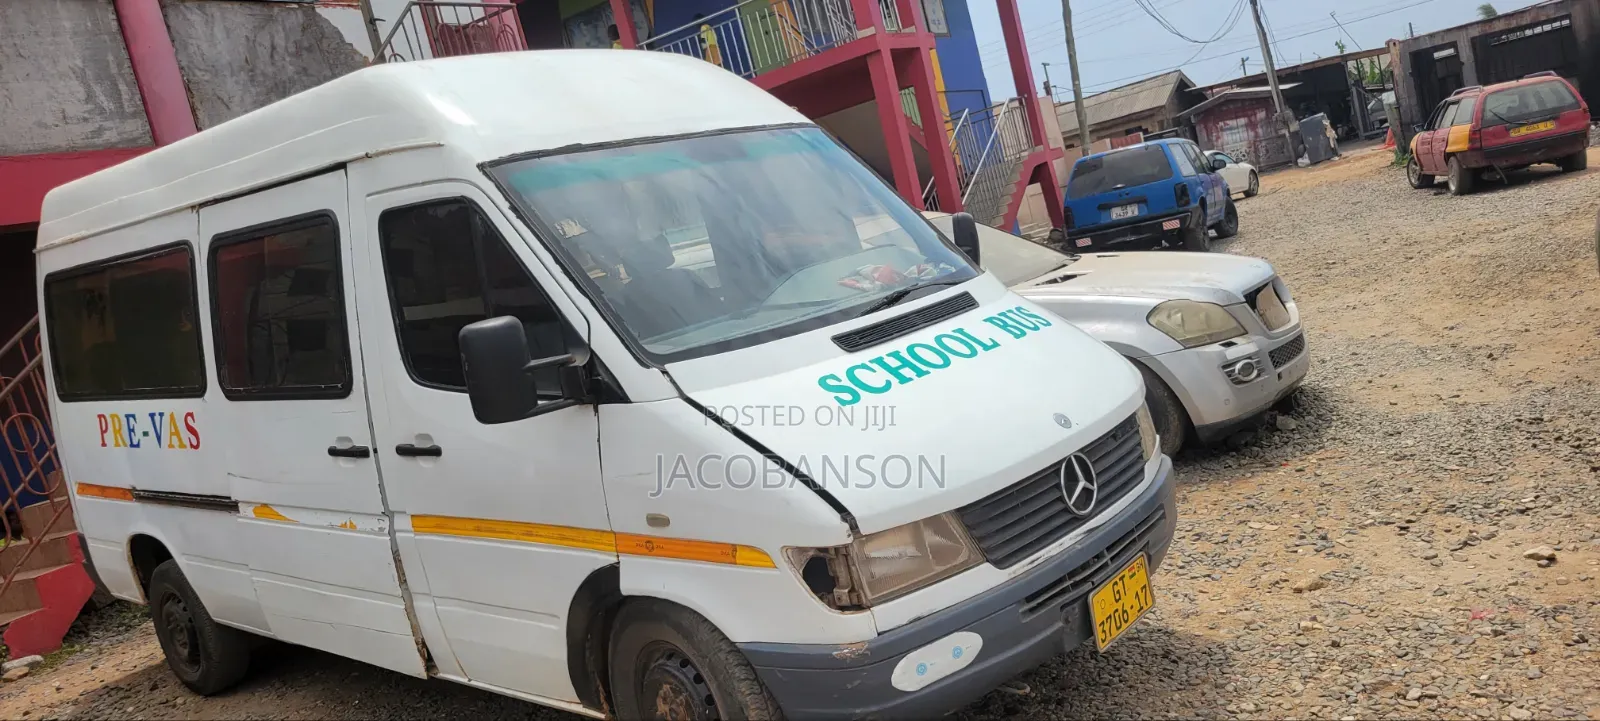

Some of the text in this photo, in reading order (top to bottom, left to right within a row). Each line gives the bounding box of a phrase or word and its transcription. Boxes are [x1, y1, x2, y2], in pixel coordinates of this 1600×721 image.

[818, 306, 1053, 406] SCHOOL BUS
[97, 411, 201, 450] PRE-VAS
[1112, 574, 1127, 603] GT
[1099, 584, 1148, 643] 3706-17
